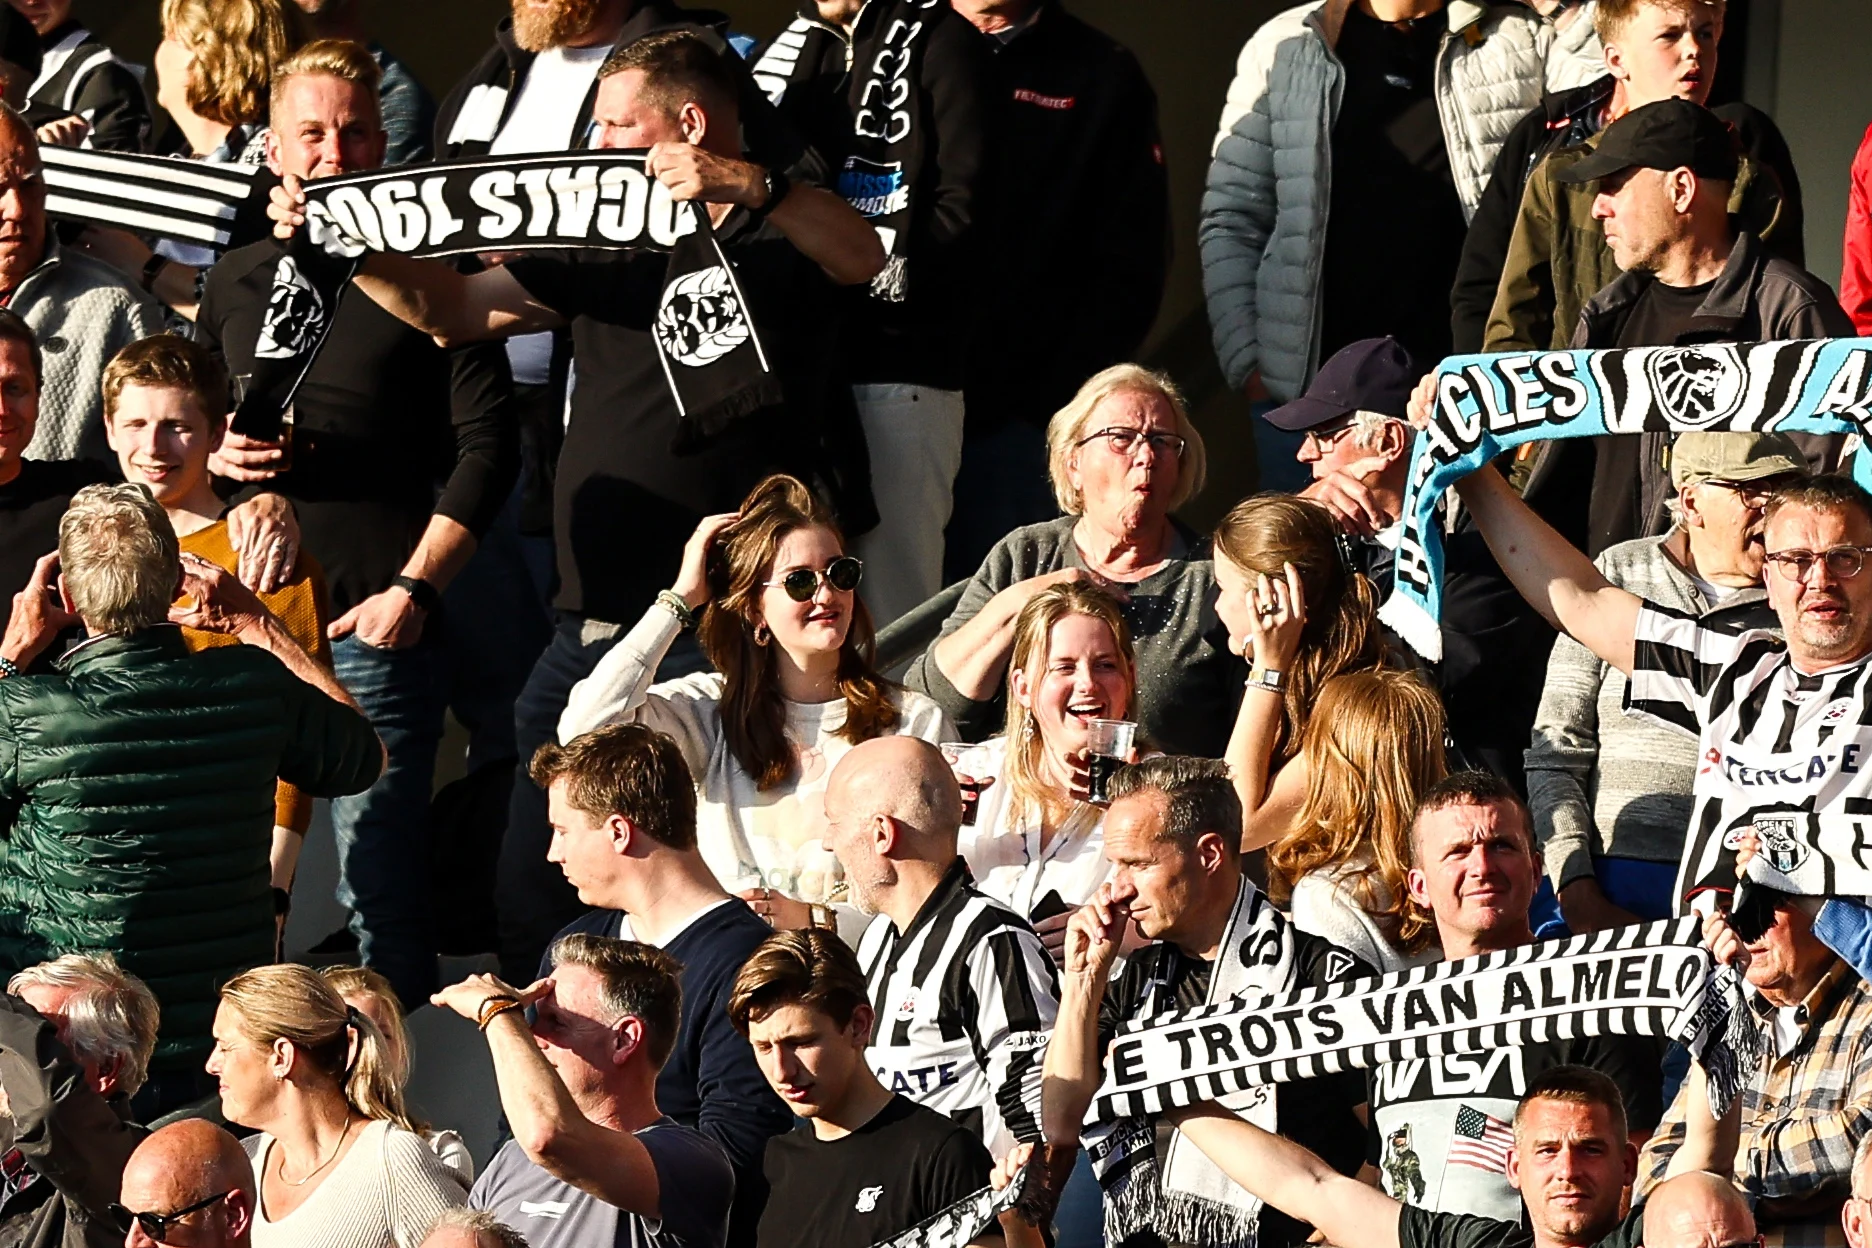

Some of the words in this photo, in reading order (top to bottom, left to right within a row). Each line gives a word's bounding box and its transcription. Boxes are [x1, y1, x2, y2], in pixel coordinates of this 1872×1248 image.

[1170, 1002, 1344, 1066] TROTS
[1361, 979, 1483, 1035] VAN
[1501, 948, 1703, 1015] ALMELO
[1018, 1035, 1047, 1047] JAKO
